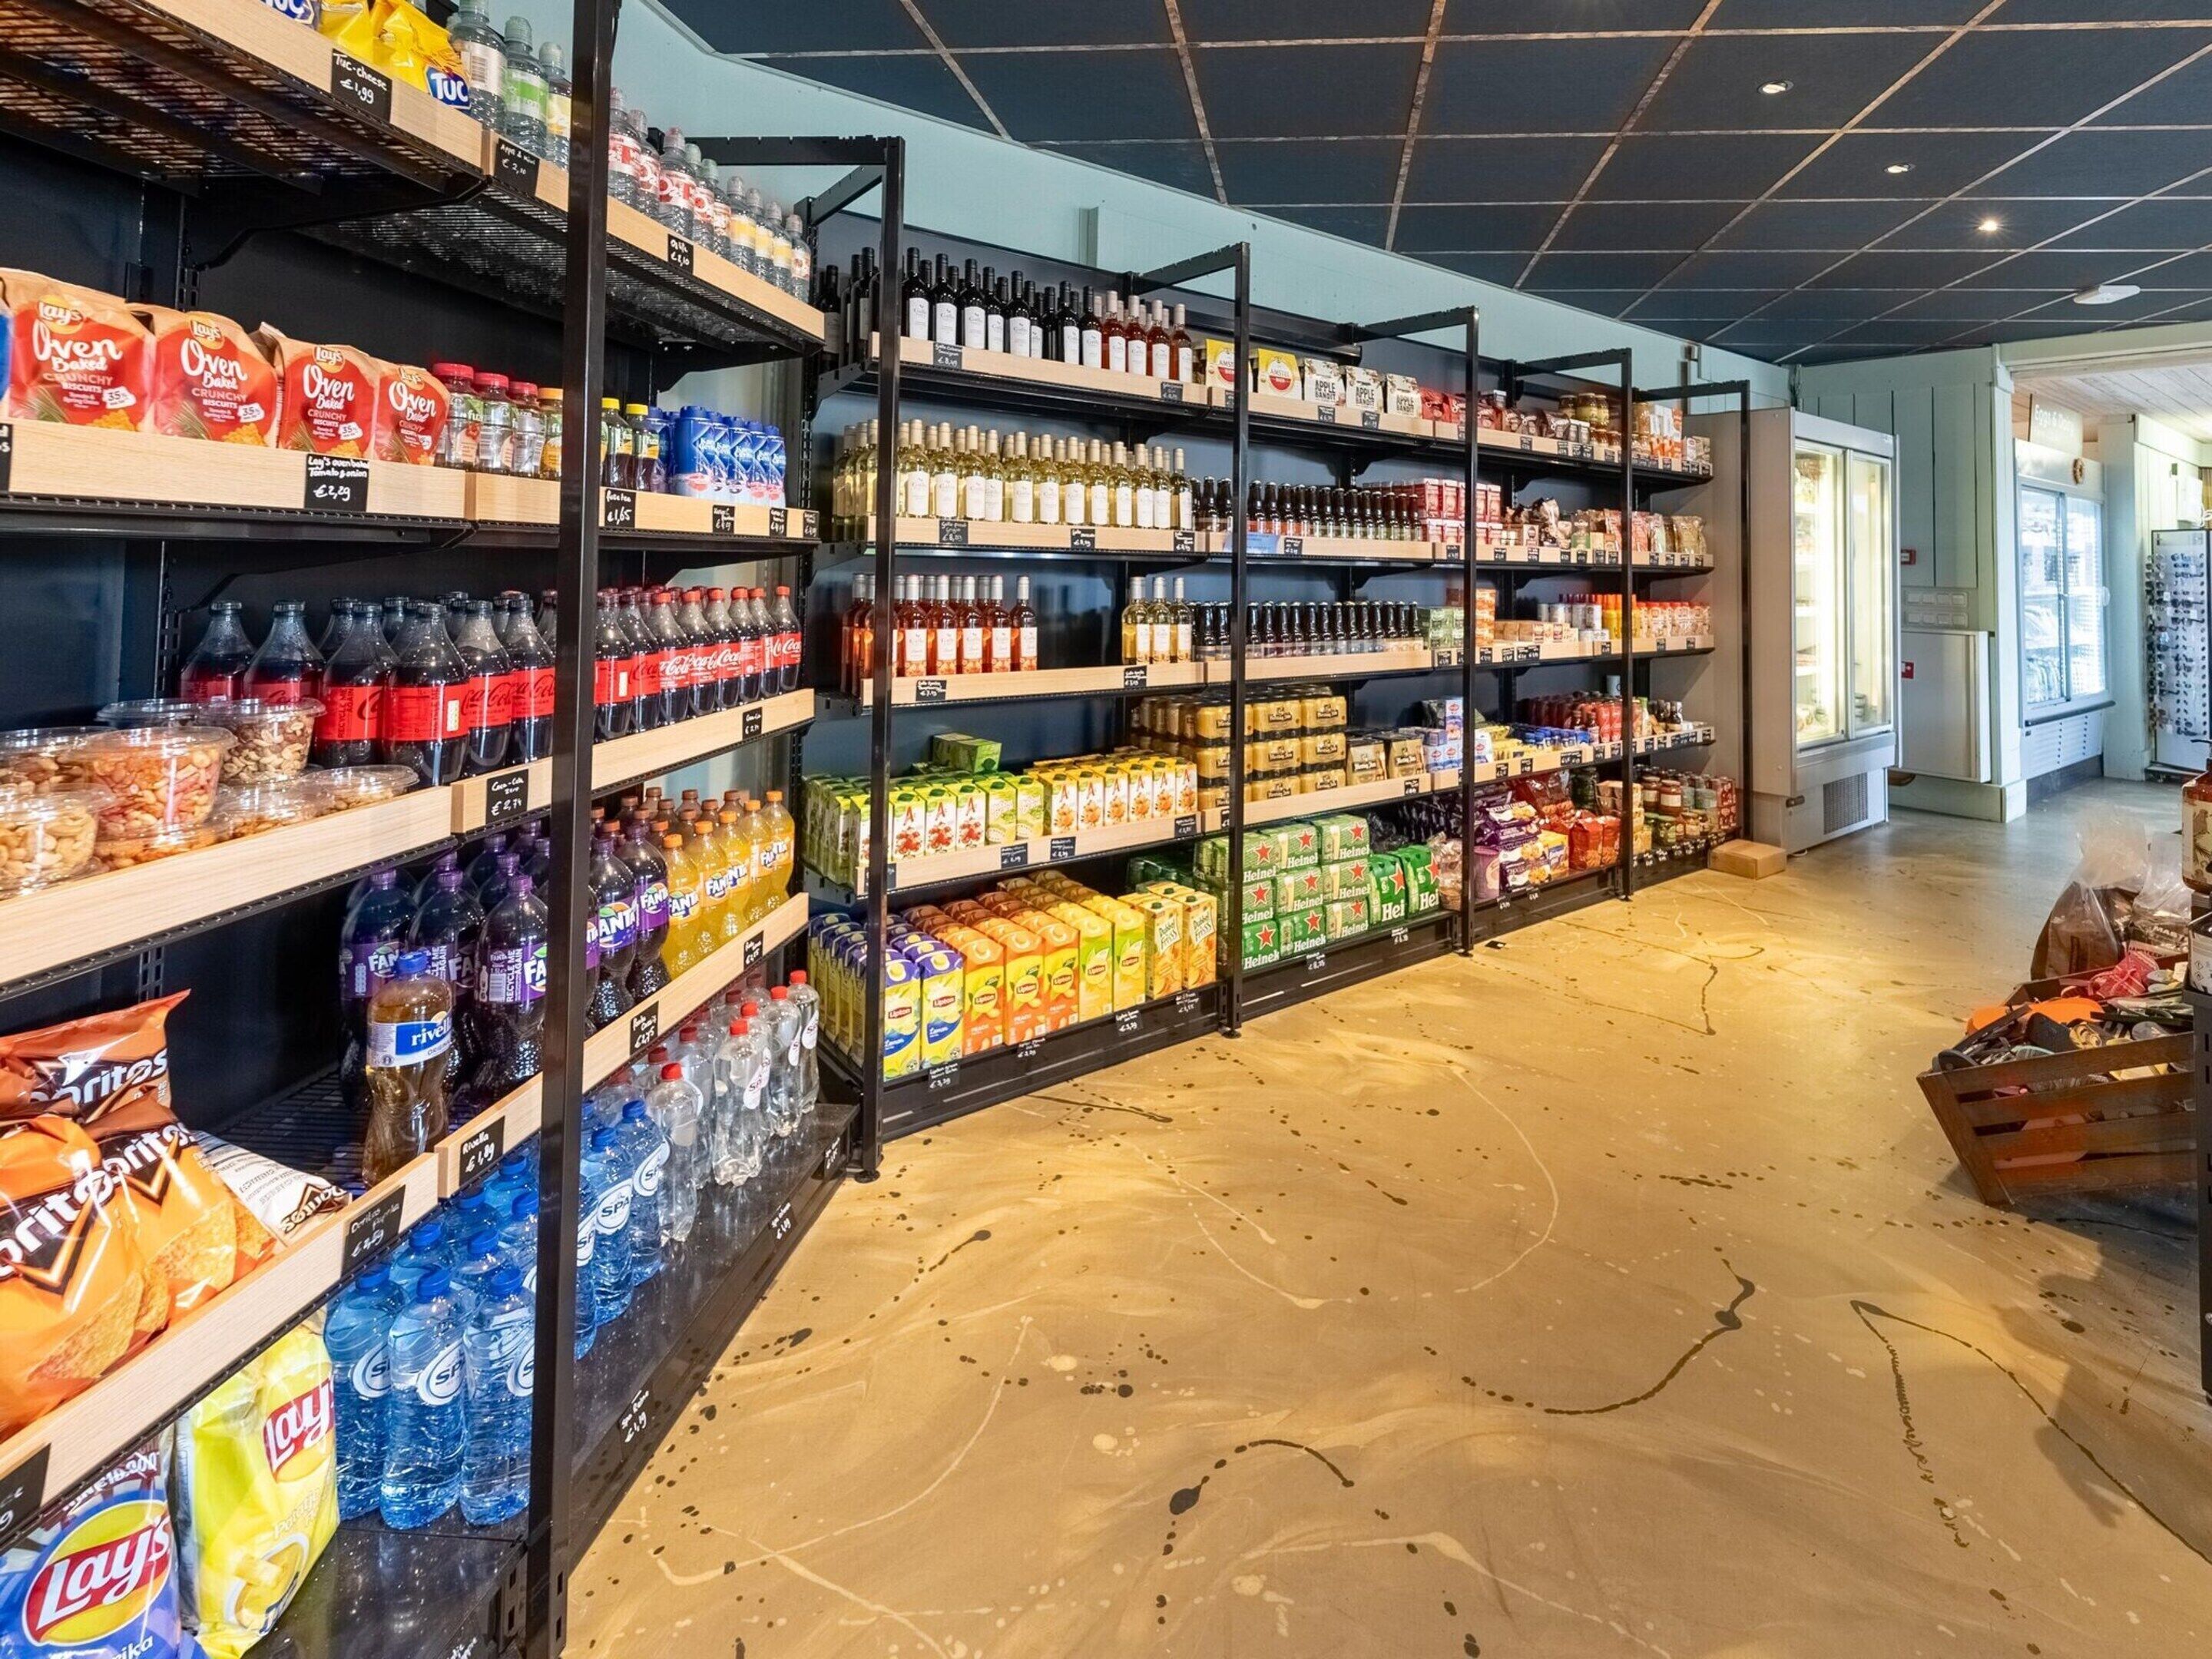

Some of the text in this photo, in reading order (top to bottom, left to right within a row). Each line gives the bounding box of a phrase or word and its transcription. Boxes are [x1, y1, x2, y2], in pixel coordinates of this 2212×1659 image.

[430, 74, 469, 102] TUC
[33, 319, 123, 361] Oven
[51, 357, 108, 372] Baked
[180, 338, 248, 381] Oven
[43, 372, 114, 386] CRUNCHY
[203, 371, 238, 390] Baked
[303, 364, 355, 402] Oven
[1316, 379, 1336, 394] APPLE
[191, 387, 247, 402] CRUNCHY
[389, 381, 436, 417] Oven
[1315, 392, 1336, 400] BANDIT
[1356, 386, 1375, 399] APPLE
[316, 394, 345, 410] Baked
[1356, 396, 1375, 406] BANDIT
[1396, 395, 1415, 407] APPLE
[1396, 404, 1415, 414] BANDIT
[307, 409, 346, 422] CRUNCHY
[600, 902, 638, 936] ANTA
[368, 949, 399, 971] FAN
[506, 962, 515, 1002] RECYCLE
[601, 1197, 629, 1220] SPA
